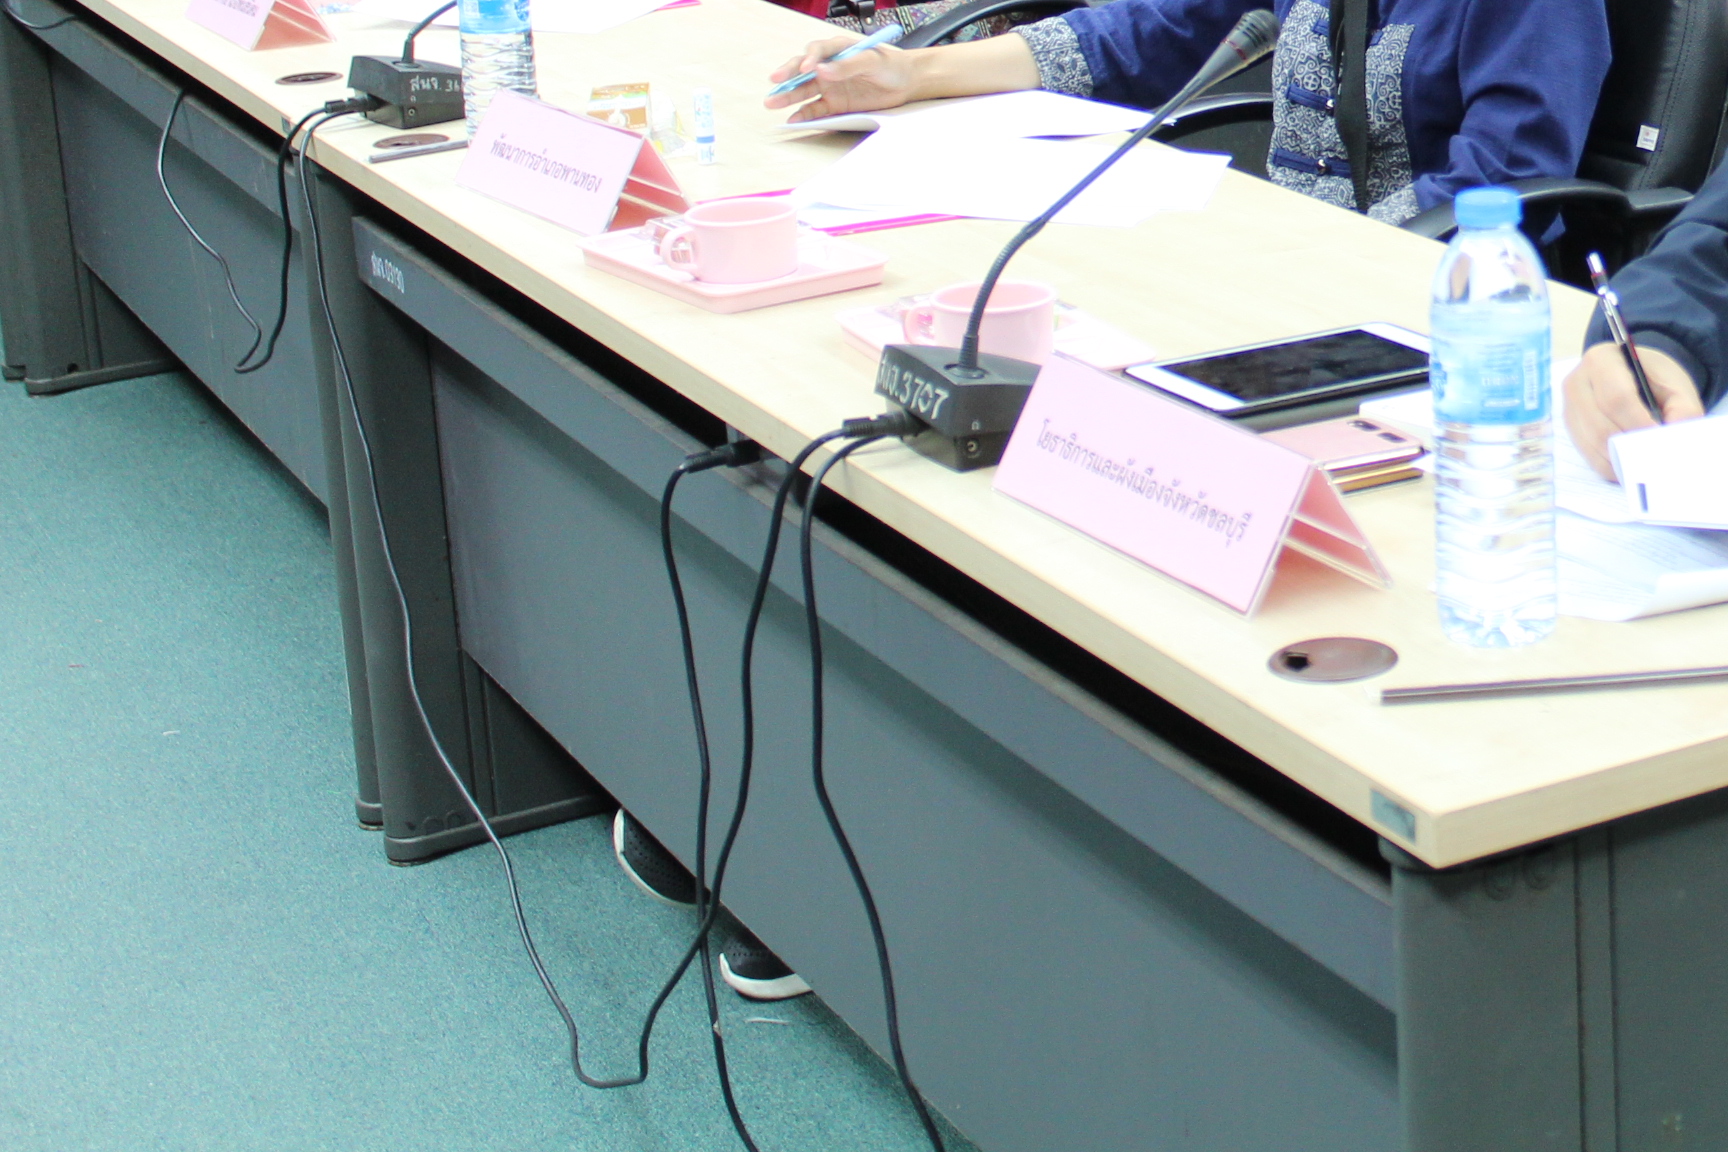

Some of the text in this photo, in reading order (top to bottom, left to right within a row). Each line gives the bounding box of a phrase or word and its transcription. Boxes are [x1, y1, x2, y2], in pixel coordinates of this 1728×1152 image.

[1036, 417, 1254, 549] โยธาธิการและผังเมืองจังหวัดชลบุรี
